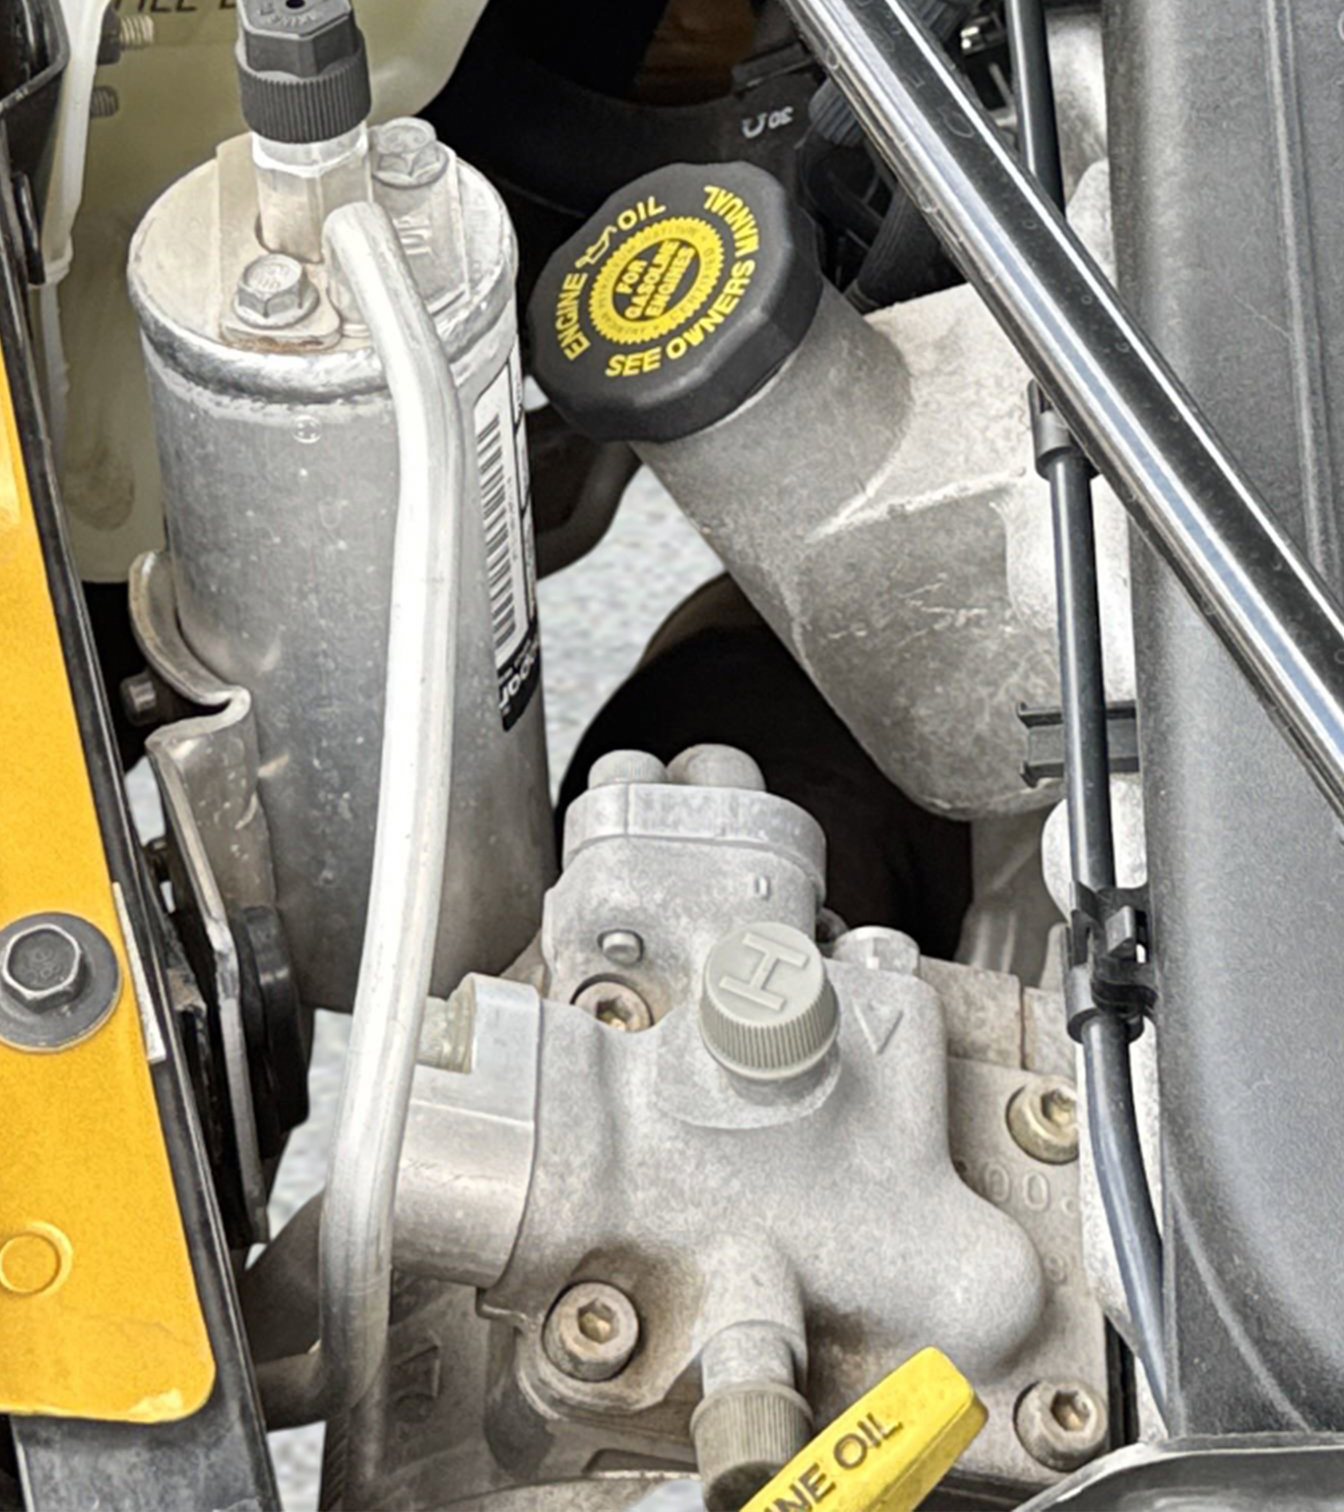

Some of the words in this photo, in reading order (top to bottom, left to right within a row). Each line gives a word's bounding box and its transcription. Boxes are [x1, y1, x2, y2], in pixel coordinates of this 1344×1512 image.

[703, 184, 761, 258] MANUAL
[555, 272, 591, 361] ENGINE
[616, 195, 667, 231] OIL
[616, 259, 647, 295] FOR
[624, 239, 681, 319] GASOLINE
[645, 245, 697, 317] ENGINES
[665, 258, 757, 360] OWNERS
[604, 346, 662, 377] SEE
[763, 1462, 837, 1512] NE
[833, 1412, 904, 1471] OIL
